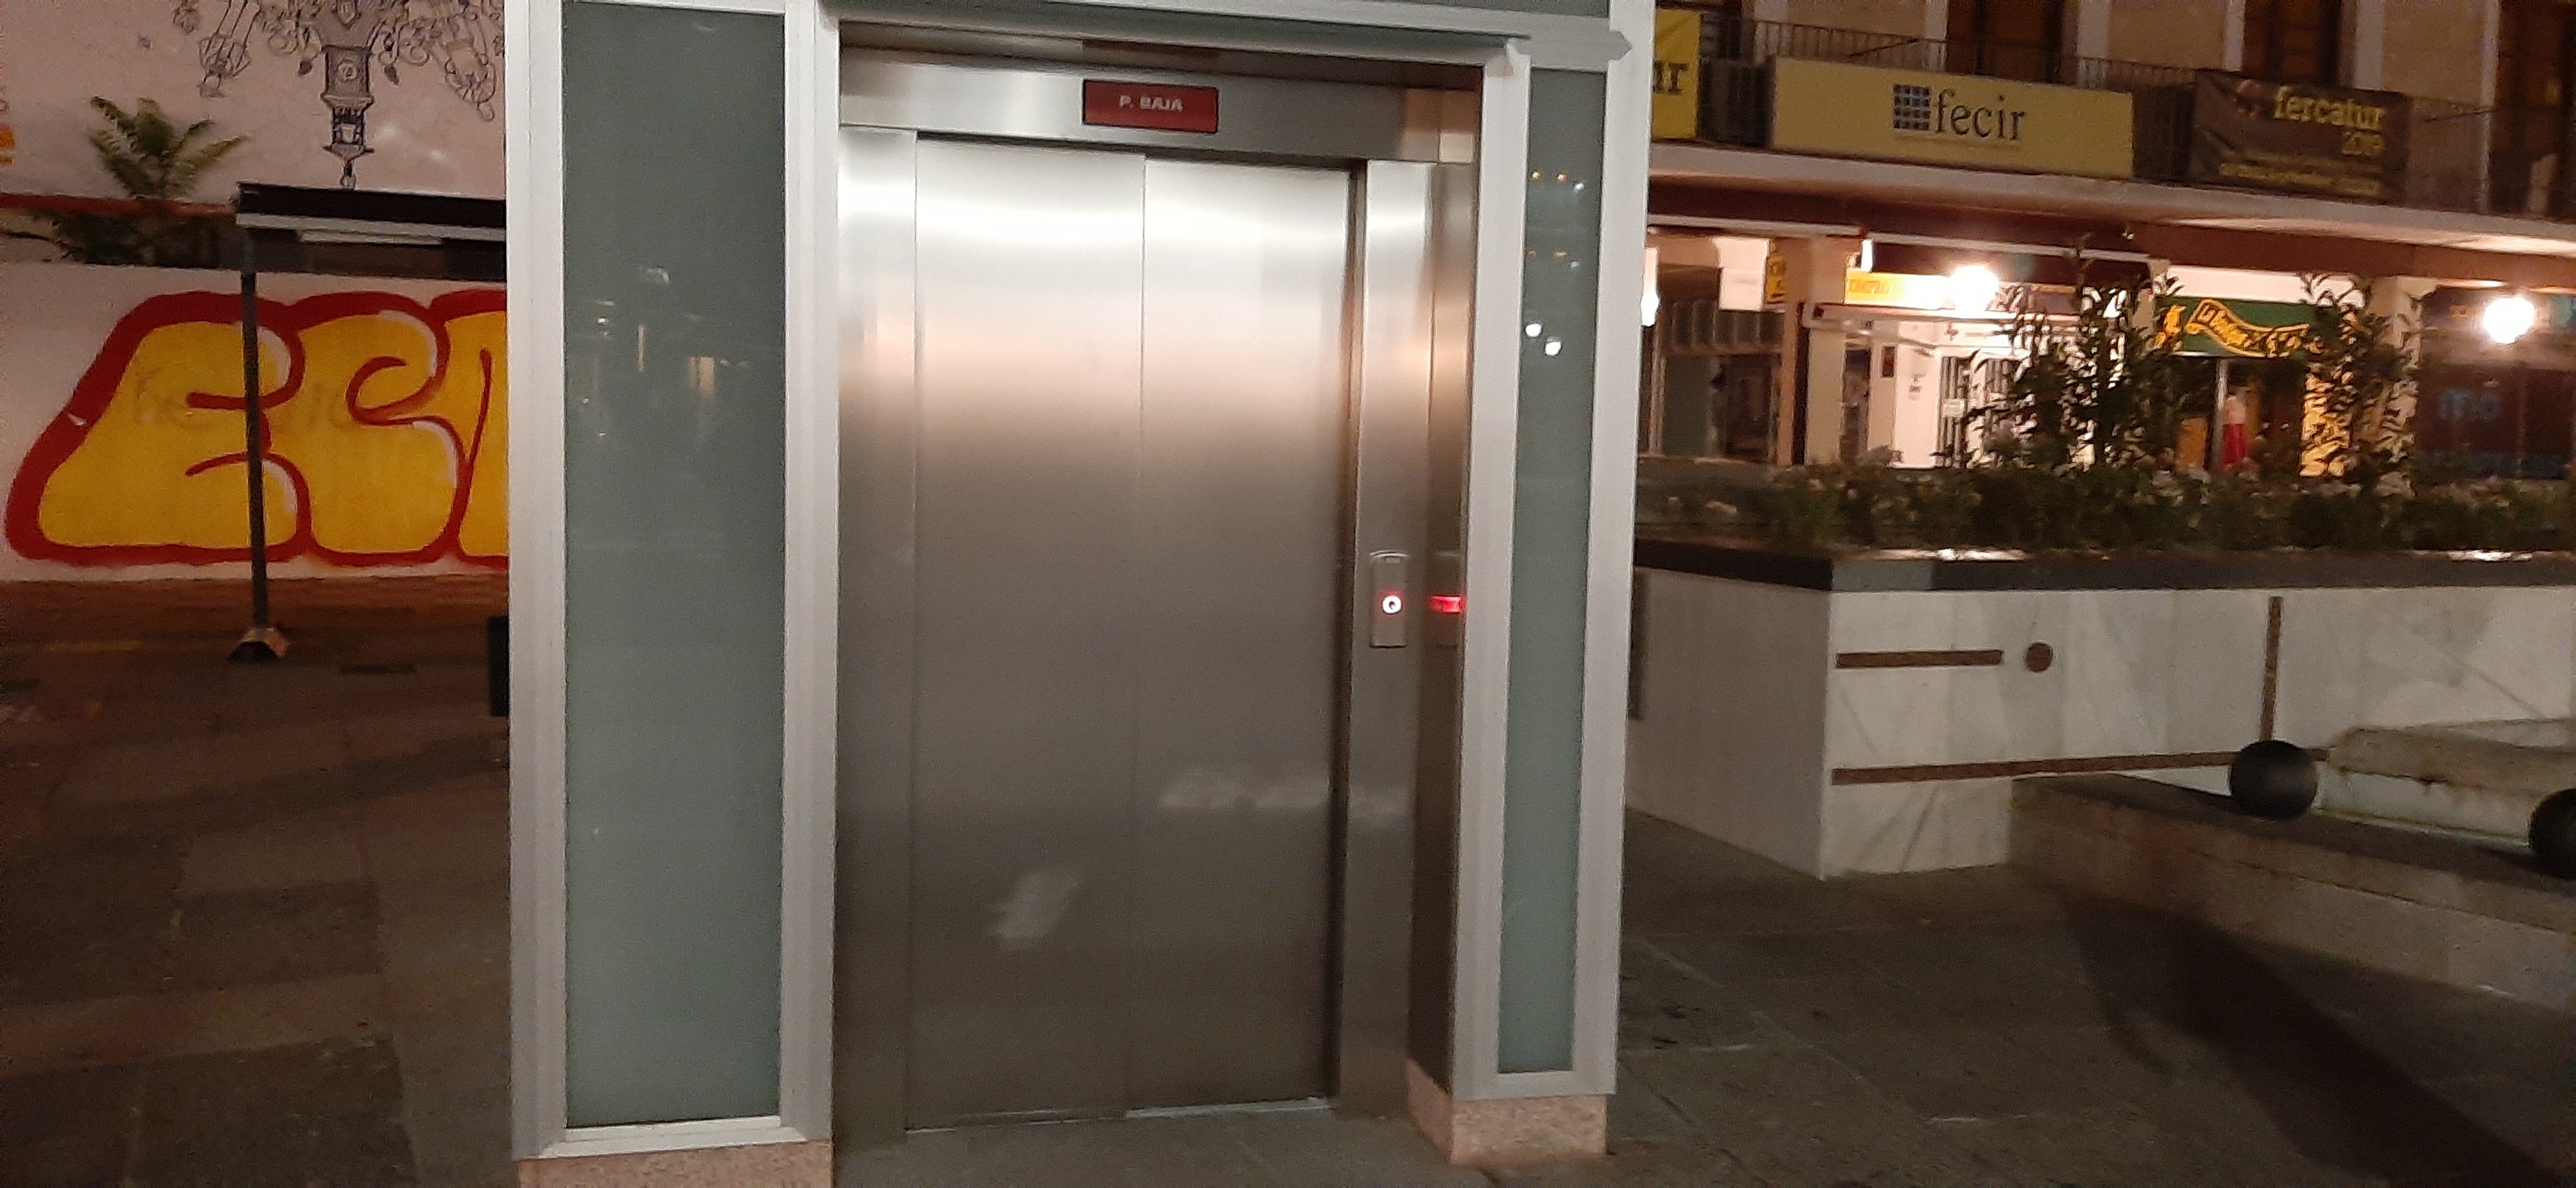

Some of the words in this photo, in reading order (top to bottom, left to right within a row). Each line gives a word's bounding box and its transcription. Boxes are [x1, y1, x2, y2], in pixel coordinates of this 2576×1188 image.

[1119, 95, 1134, 109] P.
[1140, 95, 1183, 112] BAJA
[1933, 88, 2027, 141] fecir
[2272, 85, 2386, 132] fercatur
